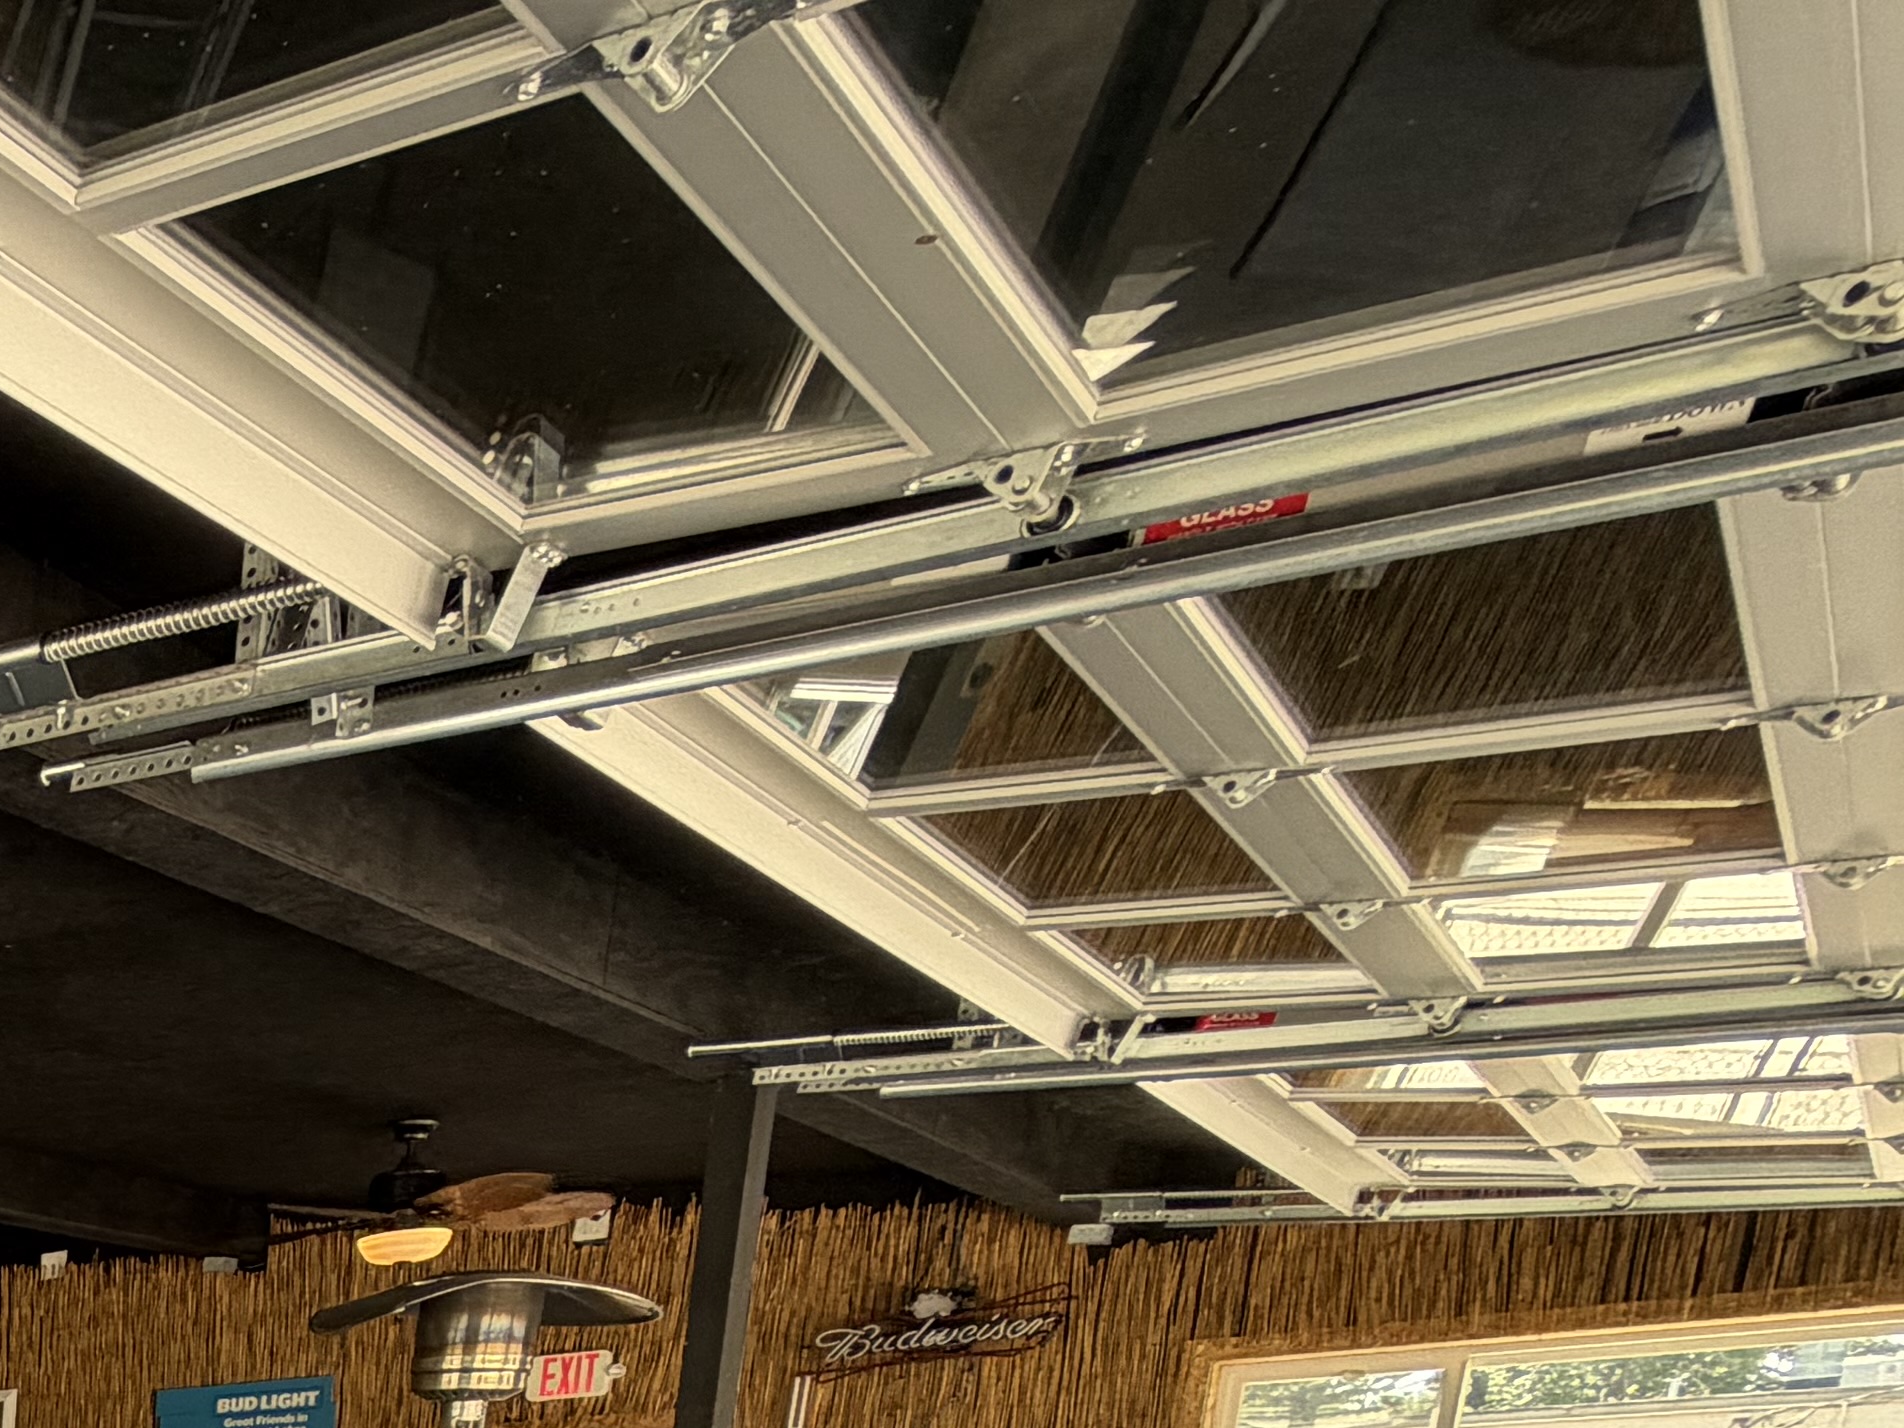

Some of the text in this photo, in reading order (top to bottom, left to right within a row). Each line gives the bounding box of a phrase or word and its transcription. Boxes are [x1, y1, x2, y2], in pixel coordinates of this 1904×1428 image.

[815, 1311, 1058, 1362] Budweiser
[538, 1352, 600, 1397] EXIT
[216, 1389, 321, 1414] BUD LIGHT
[223, 1417, 255, 1428] Great
[255, 1413, 296, 1426] Friends
